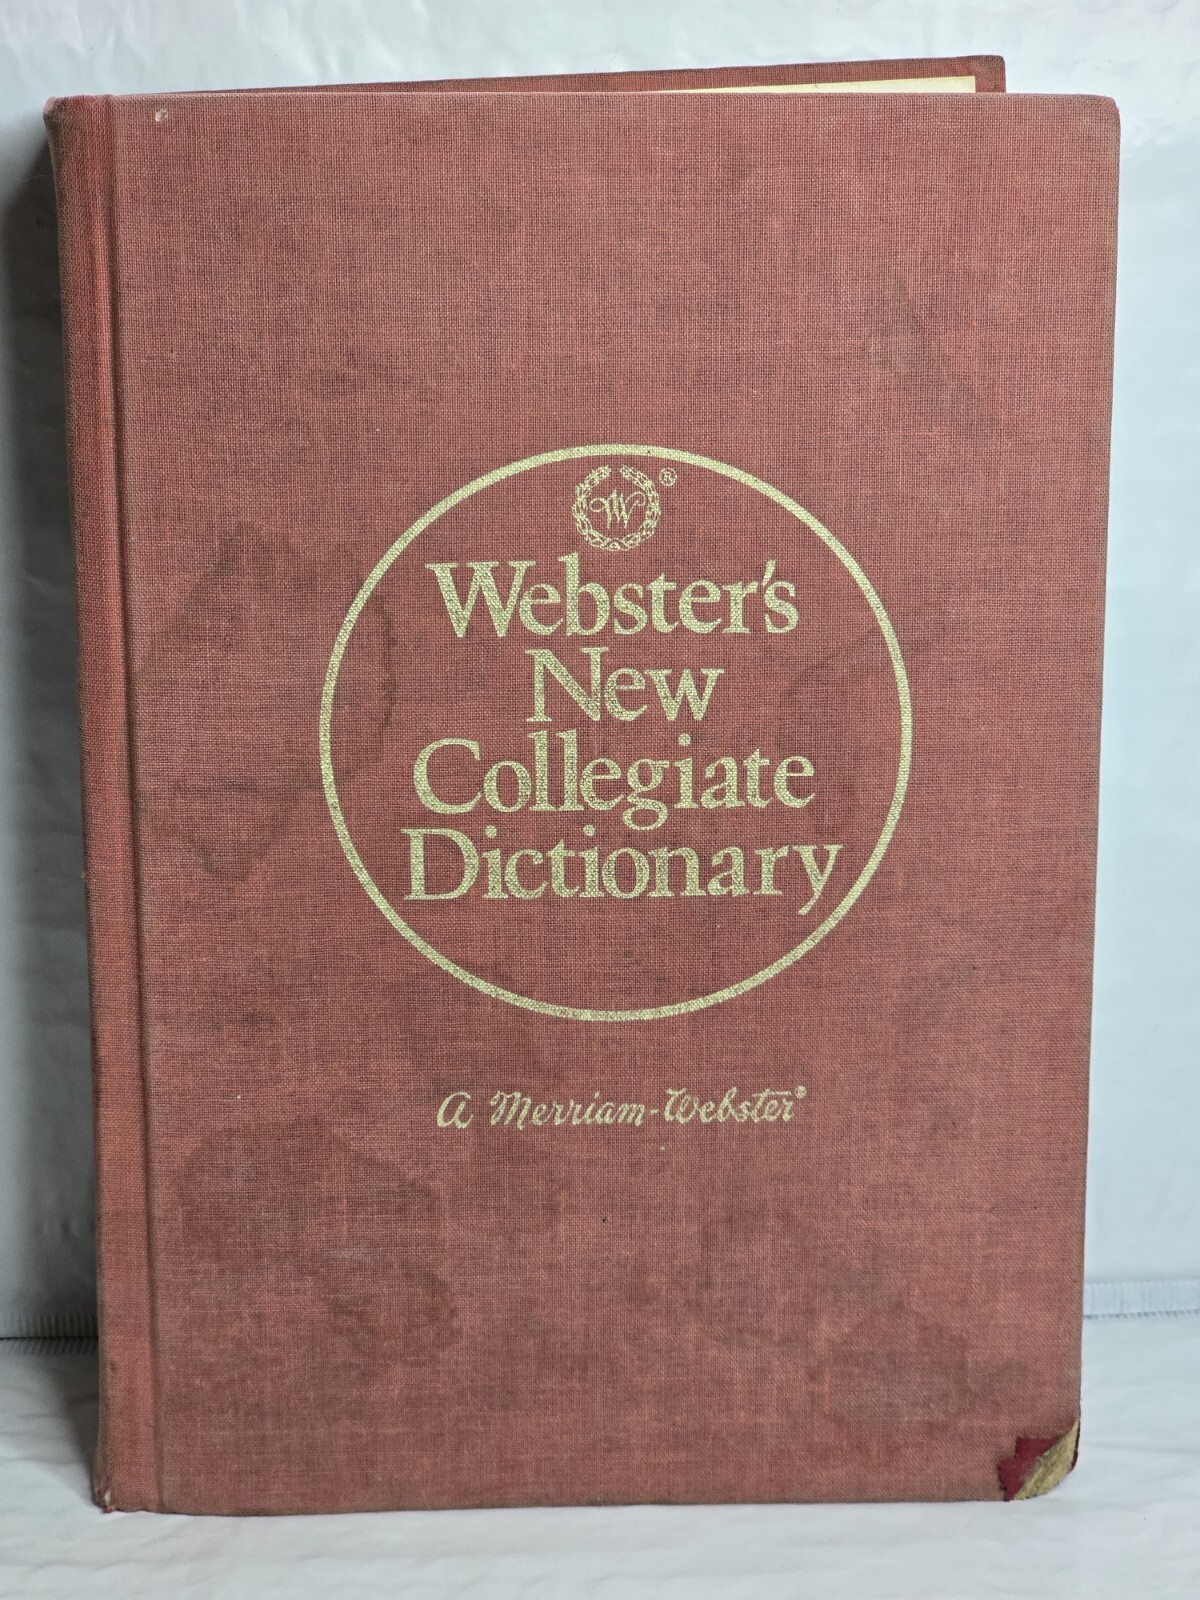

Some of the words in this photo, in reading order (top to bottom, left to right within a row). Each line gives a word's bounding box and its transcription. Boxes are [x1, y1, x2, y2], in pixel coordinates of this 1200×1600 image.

[425, 552, 800, 638] Webster's
[525, 646, 725, 723] New
[412, 729, 816, 831] Collegiate
[400, 824, 844, 916] Dictionary
